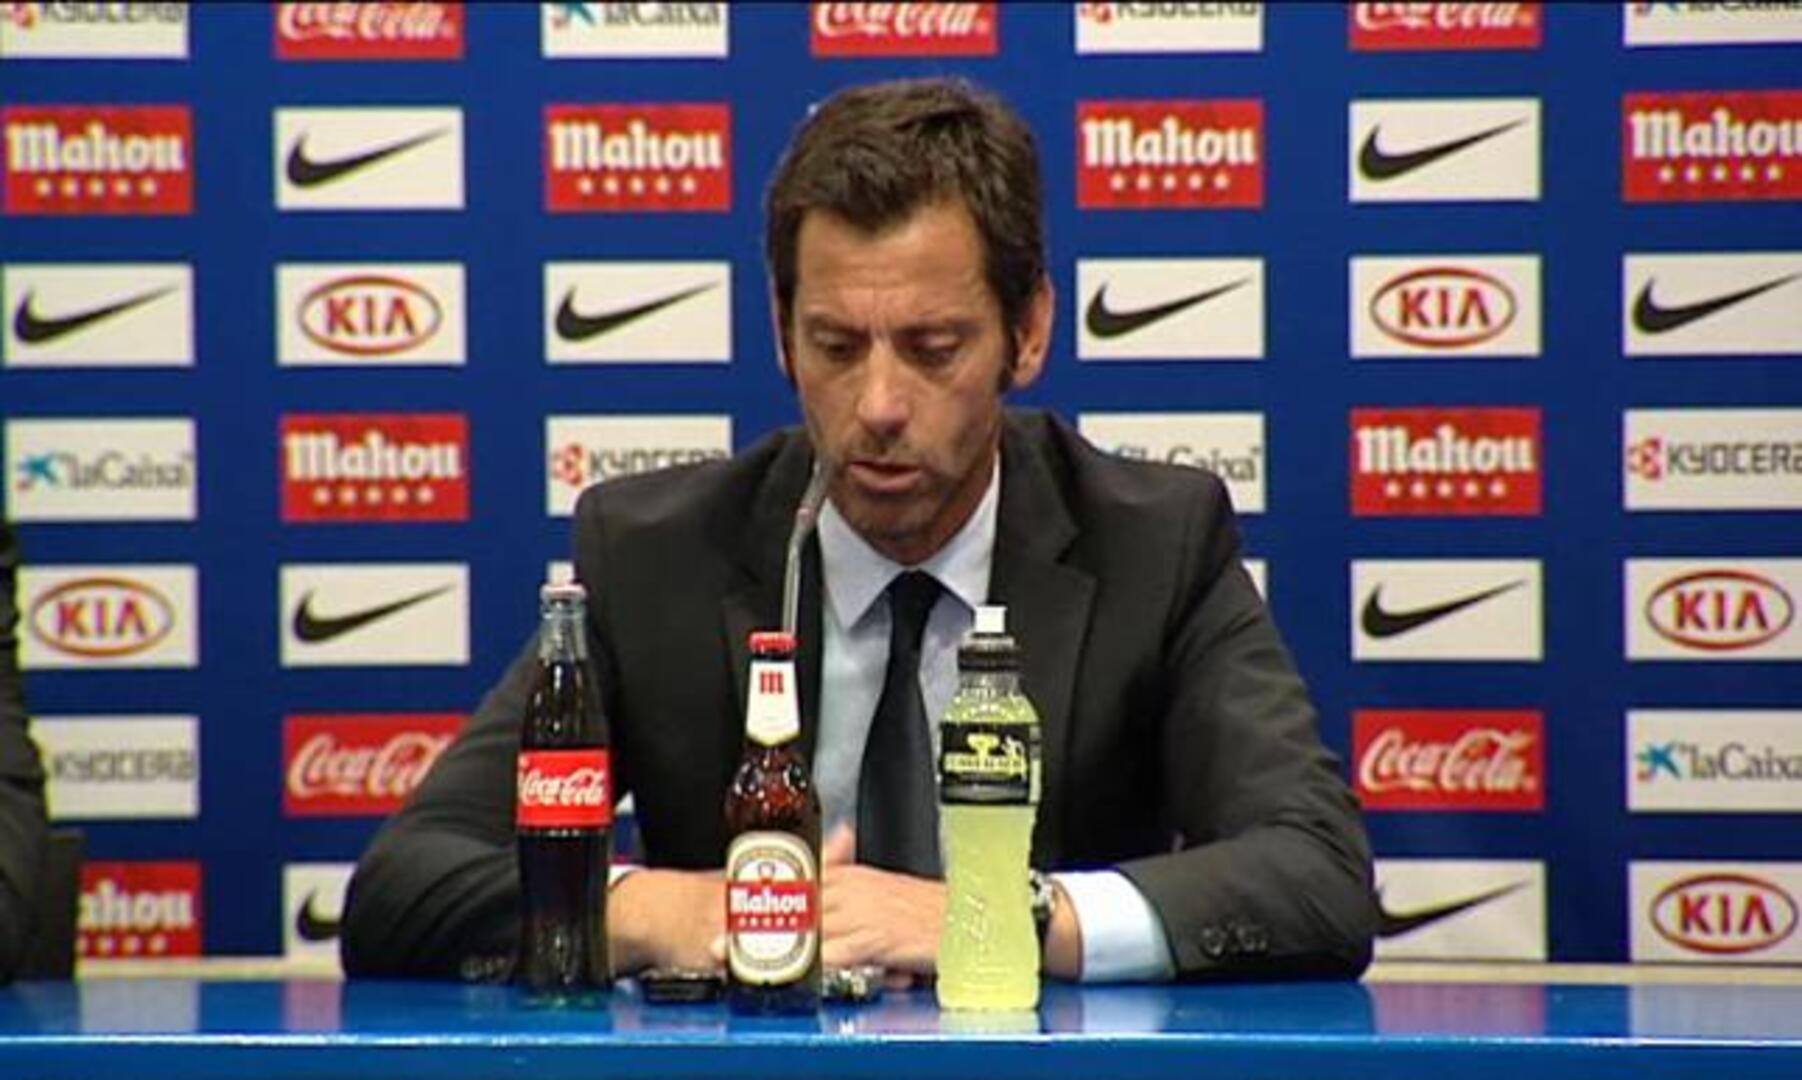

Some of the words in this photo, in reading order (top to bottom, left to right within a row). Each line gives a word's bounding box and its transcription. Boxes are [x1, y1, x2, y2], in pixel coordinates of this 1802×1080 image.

[6, 121, 185, 171] Mahou
[550, 120, 721, 170] Mahou
[1082, 116, 1256, 166] Mahou
[1630, 108, 1802, 157] Mahou
[327, 296, 417, 336] KIA
[1399, 288, 1492, 328] KIA
[286, 430, 461, 480] Mahou
[1356, 426, 1533, 475] Mahou
[56, 596, 148, 637] KIA
[1672, 590, 1770, 630] KIA
[287, 732, 455, 797] Coca-Col
[1360, 729, 1533, 793] Coca-Cola
[77, 877, 193, 931] ahou
[729, 887, 807, 915] Mahou
[1677, 893, 1776, 937] KIA
